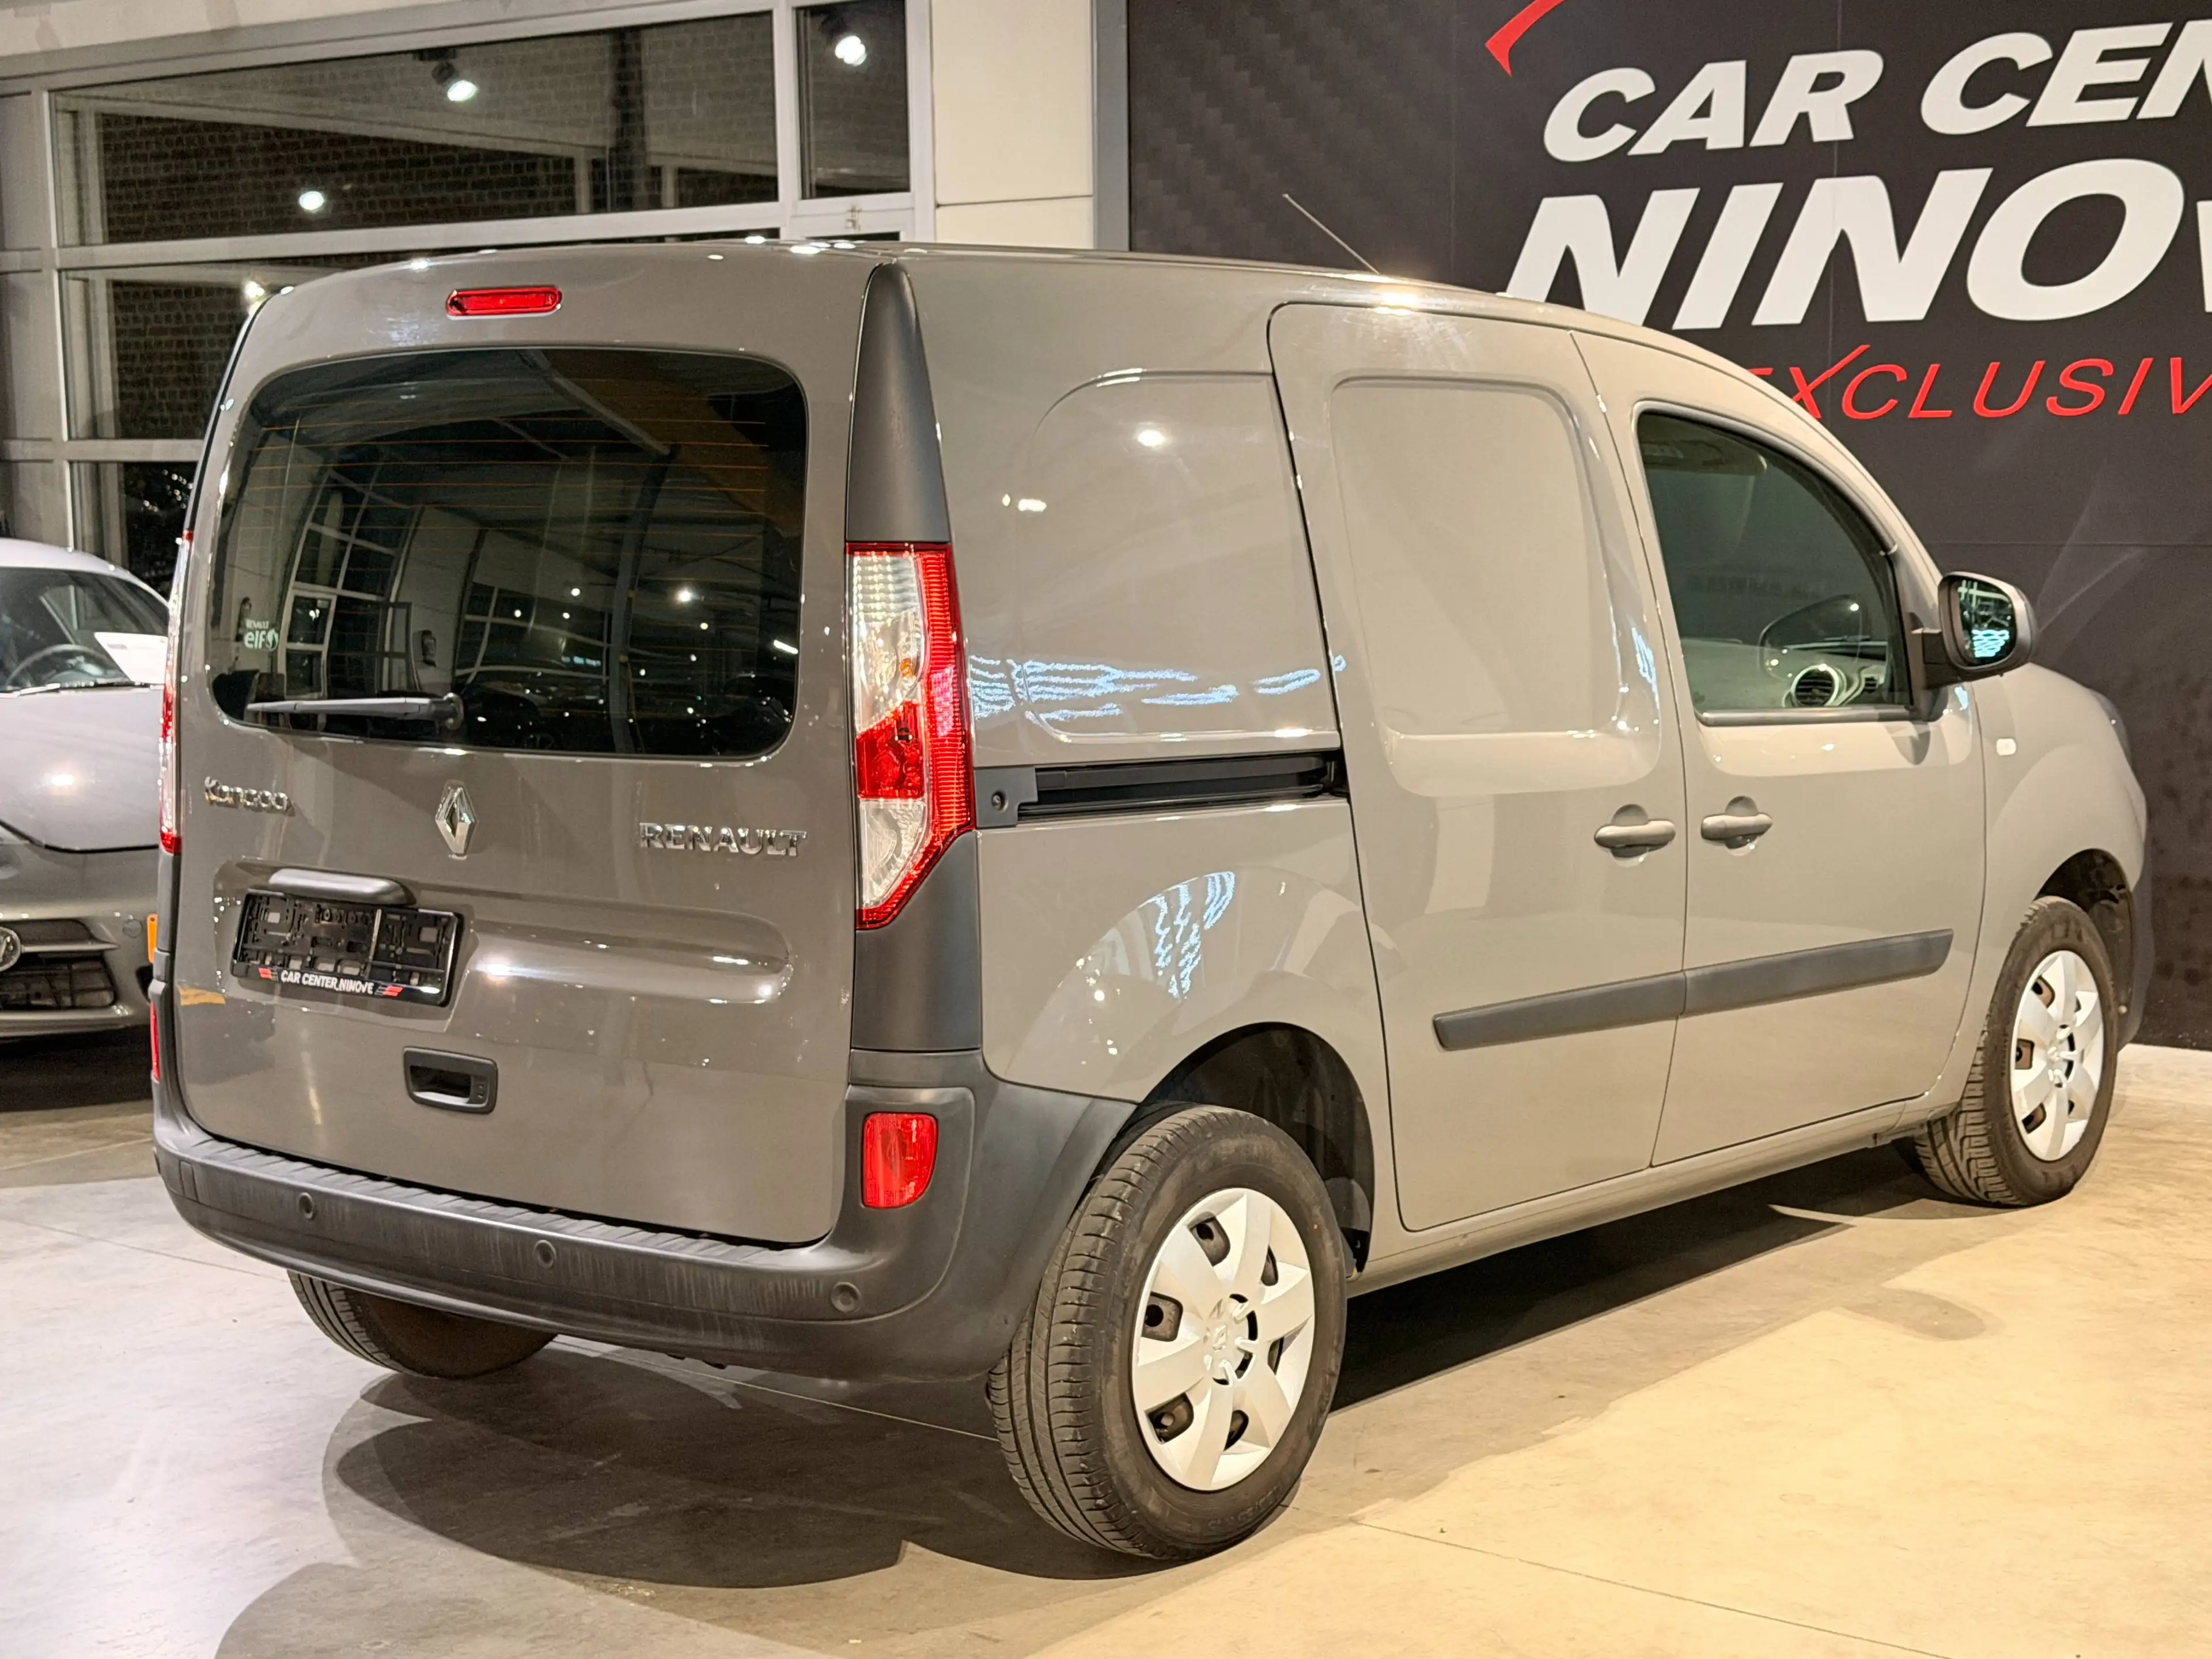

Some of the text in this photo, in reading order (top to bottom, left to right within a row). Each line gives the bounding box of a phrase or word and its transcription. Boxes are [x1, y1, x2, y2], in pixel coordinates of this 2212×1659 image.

[1544, 50, 1883, 162] CAR
[1505, 158, 2212, 330] NINO
[1746, 344, 2212, 419] XCLUSIV
[244, 630, 266, 649] elf
[639, 822, 806, 857] RENAULT
[281, 969, 301, 983] CAR
